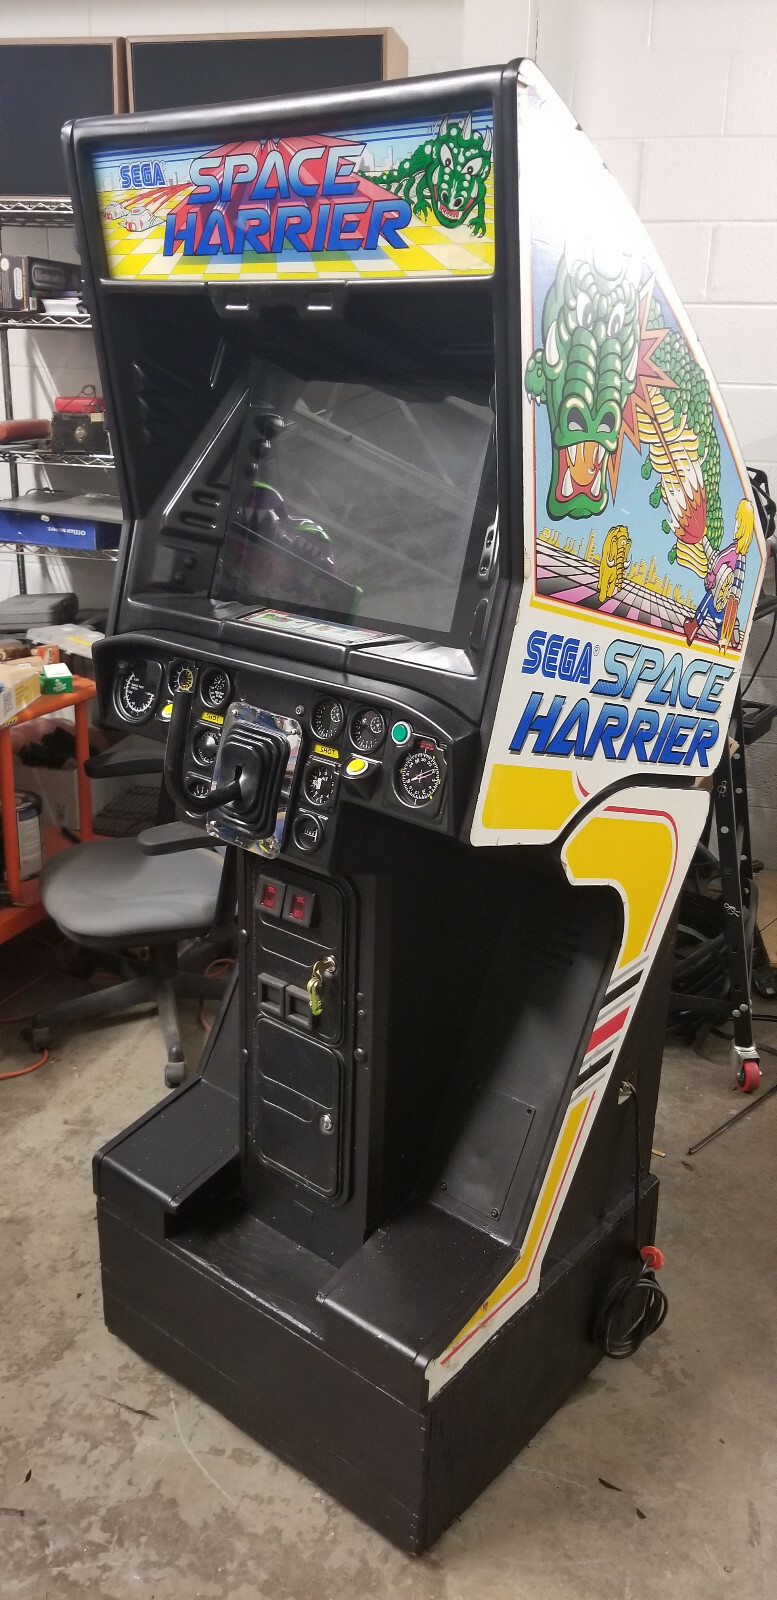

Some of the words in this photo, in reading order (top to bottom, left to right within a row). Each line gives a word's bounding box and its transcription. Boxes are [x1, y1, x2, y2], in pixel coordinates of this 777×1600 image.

[120, 161, 166, 188] SEGA
[188, 143, 366, 204] SPACE
[163, 199, 411, 256] HARRIER
[521, 630, 593, 685] SEGA
[590, 638, 735, 714] SPACE
[320, 745, 337, 755] SHOT
[508, 691, 720, 768] HARRIER
